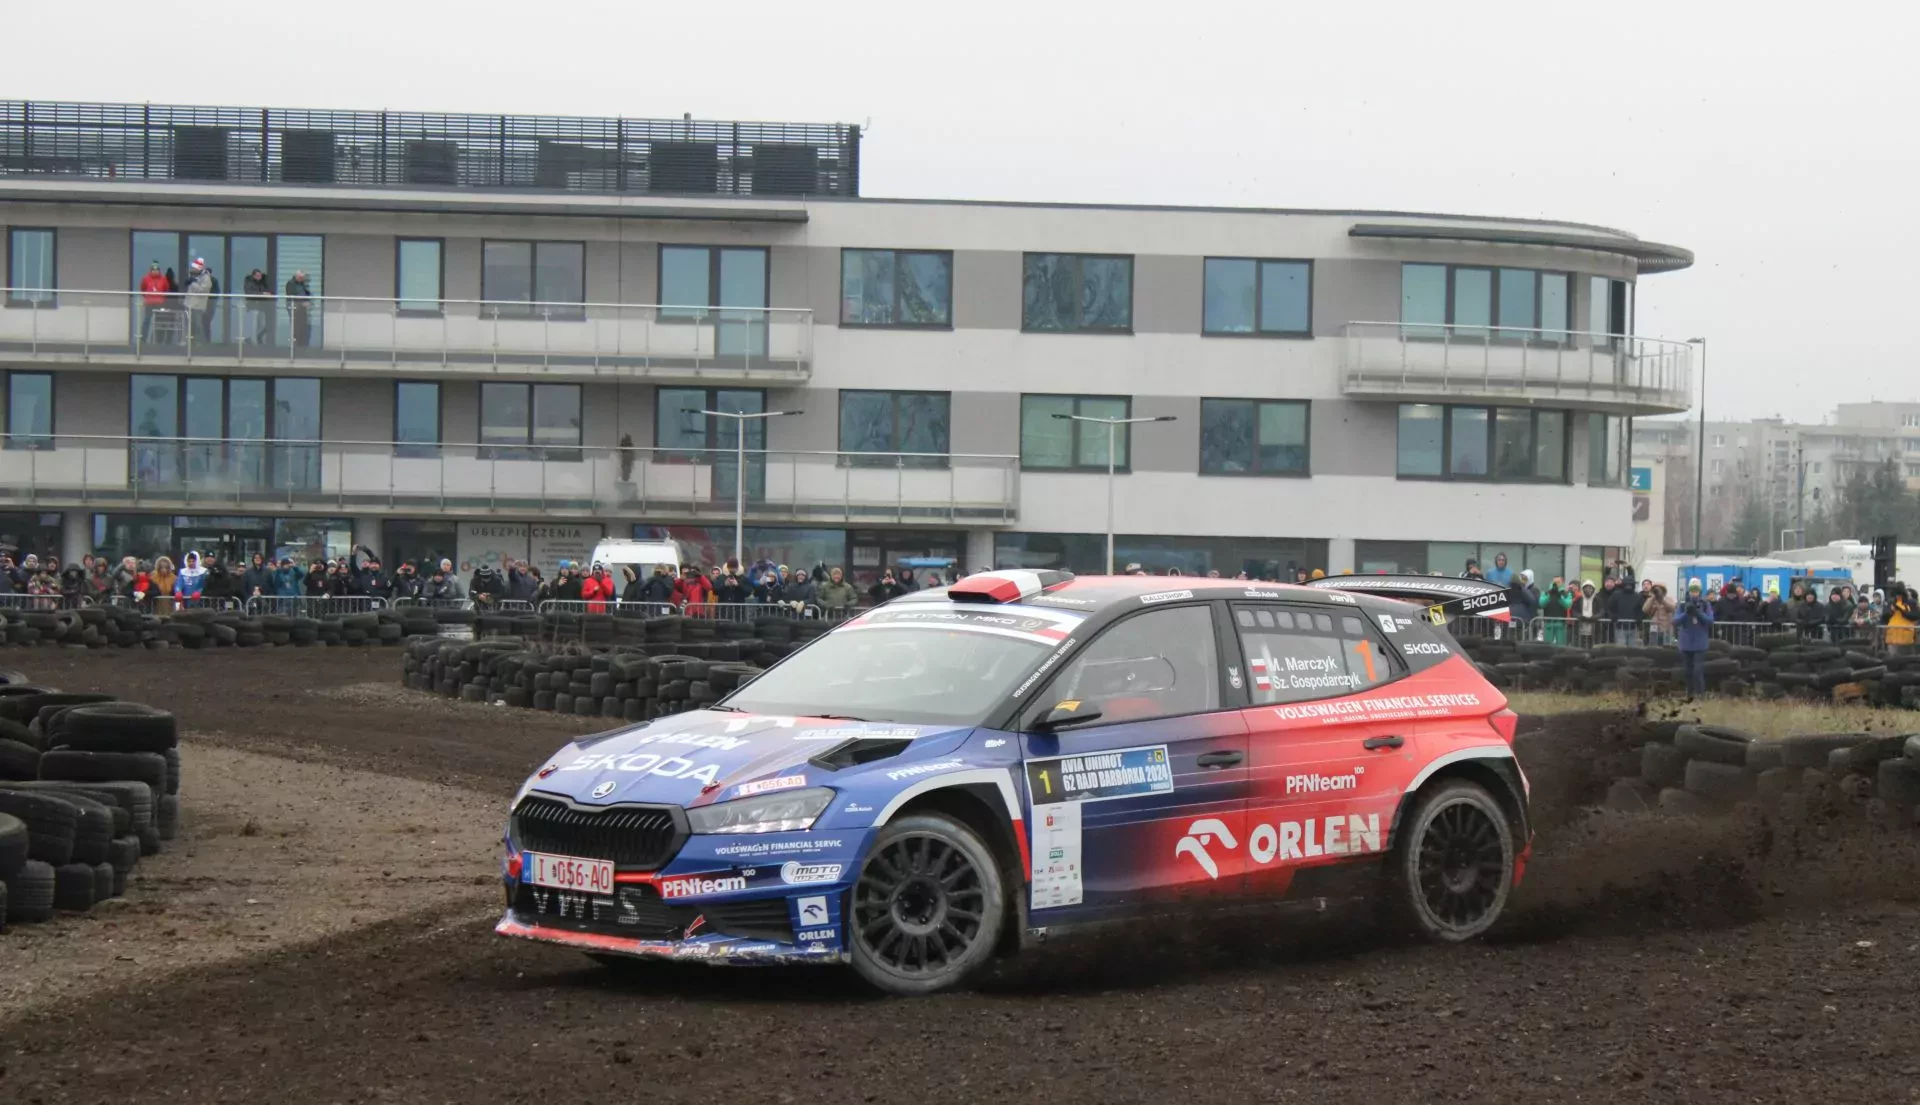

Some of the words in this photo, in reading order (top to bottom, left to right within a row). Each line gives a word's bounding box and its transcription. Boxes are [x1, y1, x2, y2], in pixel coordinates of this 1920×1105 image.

[1384, 582, 1440, 591] FINANCIAL
[1443, 584, 1495, 596] SERVICES
[1271, 658, 1284, 672] M.
[1285, 655, 1338, 673] Marczyk
[1353, 639, 1377, 683] 1
[1013, 671, 1041, 698] VOLKSWAGEN
[1038, 653, 1061, 674] FINANCIAL
[1273, 676, 1290, 690] Sz.
[1290, 673, 1362, 690] Gospodarczyk
[1274, 699, 1364, 720] VOLKSWAGEN
[1365, 694, 1428, 711] FINANCIAL
[1429, 692, 1481, 707] SERVICES
[1061, 759, 1085, 774] AVIA
[1084, 753, 1122, 770] UNIMOT
[1353, 766, 1365, 775] 100
[1039, 770, 1051, 794] 1
[1062, 774, 1077, 792] 62
[1077, 770, 1100, 790] RAJD
[1144, 764, 1169, 782] 2024
[1286, 774, 1357, 794] PFNteam
[715, 843, 769, 856] VOLKSWAGEN
[770, 841, 812, 851] FINANCIAL
[814, 839, 842, 848] SERVIC
[1249, 813, 1381, 864] ORLEN
[741, 868, 756, 877] 100
[662, 876, 746, 899] PFNteam
[798, 929, 835, 941] ORLEN
